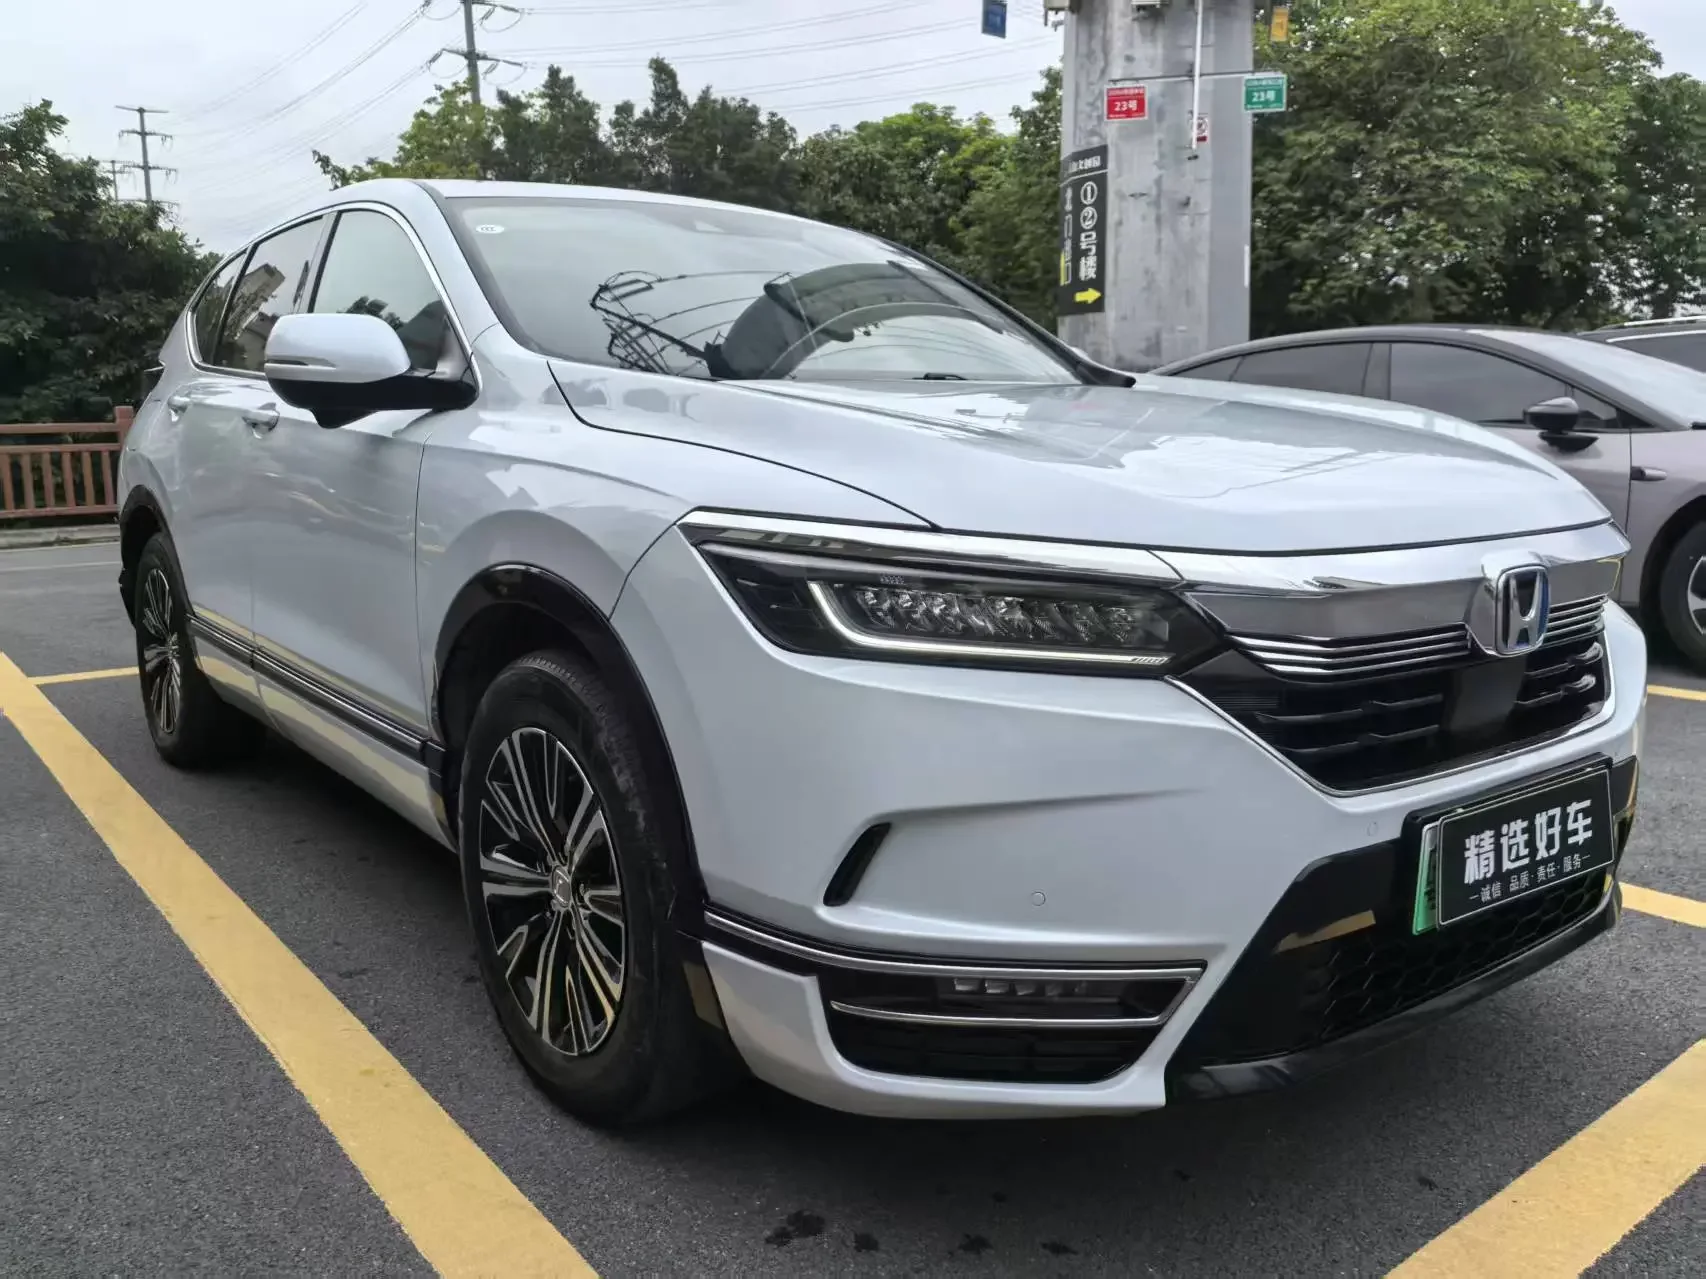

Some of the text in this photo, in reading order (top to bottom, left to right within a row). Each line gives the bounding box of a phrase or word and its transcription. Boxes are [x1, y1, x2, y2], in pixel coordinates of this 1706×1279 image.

[1114, 100, 1137, 111] 23号
[1464, 799, 1593, 885] 精选好车
